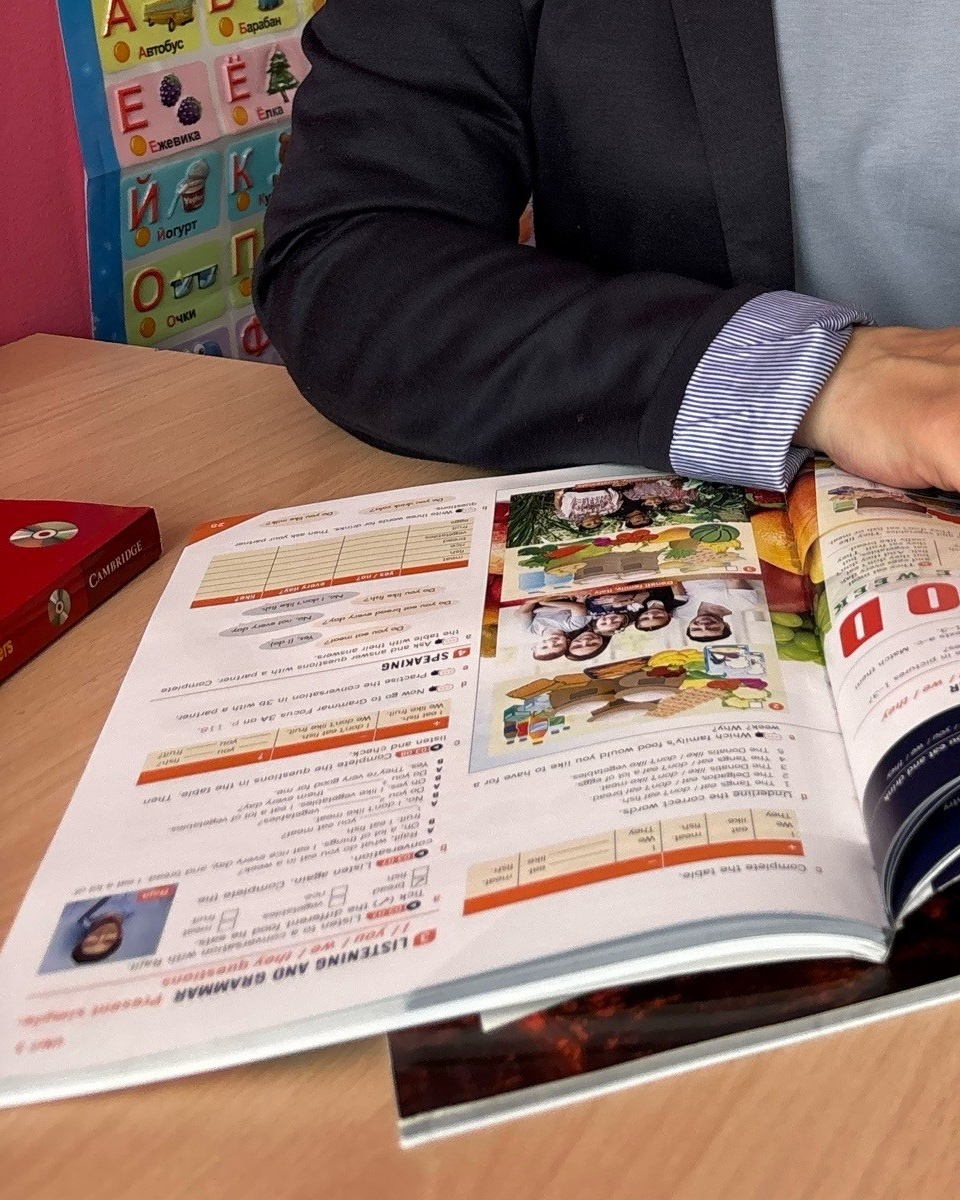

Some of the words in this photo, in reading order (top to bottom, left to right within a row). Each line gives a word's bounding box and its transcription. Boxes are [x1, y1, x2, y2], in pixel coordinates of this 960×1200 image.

[240, 16, 282, 35] Барабан
[138, 39, 184, 60] Автобус
[115, 85, 148, 133] Е
[224, 55, 251, 103] Ё
[259, 105, 284, 122] Ёлка
[149, 130, 201, 153] Ежевика
[128, 174, 159, 231] Й
[231, 148, 254, 195] К
[157, 220, 198, 242] Йогурт
[132, 267, 165, 313] О
[232, 228, 258, 277] П
[167, 309, 197, 328] Очки
[89, 540, 143, 588] CAMBRIDGE
[833, 570, 917, 618] WEEK
[414, 633, 439, 643] table
[442, 630, 459, 638] the
[361, 642, 384, 652] their
[388, 638, 410, 648] with
[391, 643, 410, 654] and
[414, 640, 431, 649] Ask
[314, 647, 357, 659] answers.
[351, 647, 387, 658] answer
[297, 651, 347, 668] questions
[381, 651, 449, 671] SPEAKING
[218, 668, 257, 681] partner.
[271, 664, 293, 675] with
[384, 671, 427, 685] Practise
[161, 681, 212, 694] Complete
[364, 680, 380, 689] the
[290, 683, 360, 702] conversation
[384, 690, 398, 700] go
[402, 688, 424, 697] Now
[259, 699, 274, 708] 3b
[277, 697, 288, 705] in
[317, 698, 367, 712] Grammar
[371, 695, 380, 704] to
[176, 706, 218, 720] partner.
[232, 702, 255, 713] with
[279, 707, 313, 719] Focus
[242, 717, 256, 725] on
[260, 714, 276, 724] 3A
[713, 724, 741, 732] Why?
[746, 724, 779, 732] week?
[415, 734, 446, 746] listen
[666, 733, 711, 745] family's
[715, 732, 751, 741] Which
[350, 744, 387, 757] check.
[391, 740, 411, 751] and
[637, 741, 662, 753] food
[929, 744, 947, 758] eat
[575, 752, 596, 763] you
[599, 746, 634, 759] would
[338, 752, 392, 769] Complete
[550, 760, 570, 770] like
[907, 756, 926, 775] and
[253, 765, 311, 783] questions
[315, 763, 333, 773] the
[535, 765, 546, 774] to
[504, 769, 531, 781] have
[215, 780, 234, 790] the
[239, 777, 250, 787] in
[483, 777, 500, 786] for
[884, 774, 905, 801] drink
[179, 784, 211, 797] table.
[143, 793, 172, 803] Then
[719, 865, 741, 875] the
[745, 861, 806, 873] Complete
[679, 868, 715, 880] table.
[315, 937, 408, 971] LISTENING
[273, 960, 310, 981] AND
[173, 971, 266, 1003] GRAMMAR
